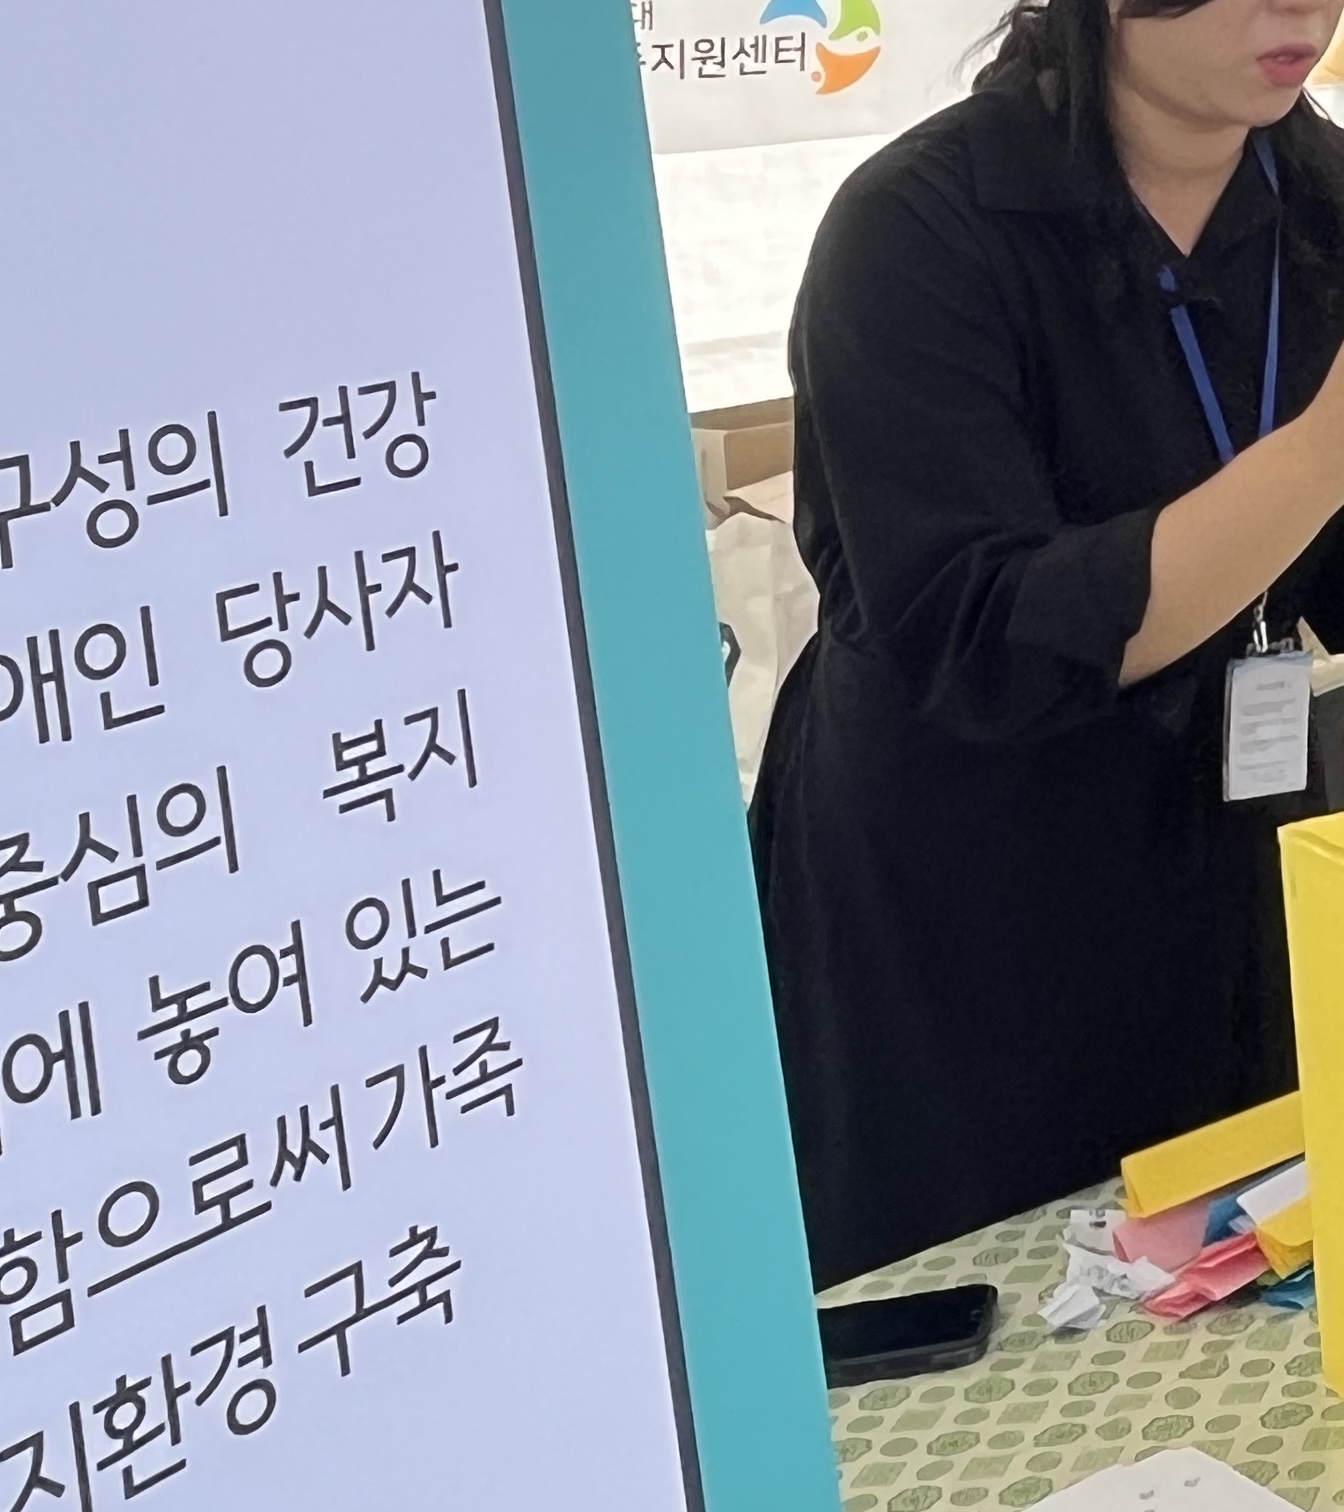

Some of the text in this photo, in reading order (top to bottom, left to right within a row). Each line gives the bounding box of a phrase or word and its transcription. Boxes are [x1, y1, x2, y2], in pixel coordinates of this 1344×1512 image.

[635, 31, 806, 81] 지원센터
[277, 371, 437, 498] 건강
[215, 529, 460, 689] 당사자
[322, 688, 478, 823] 복지
[1, 868, 503, 1120] 에 놓여 있는
[0, 1016, 524, 1356] 함으로써 가족
[297, 1225, 462, 1378] 구축
